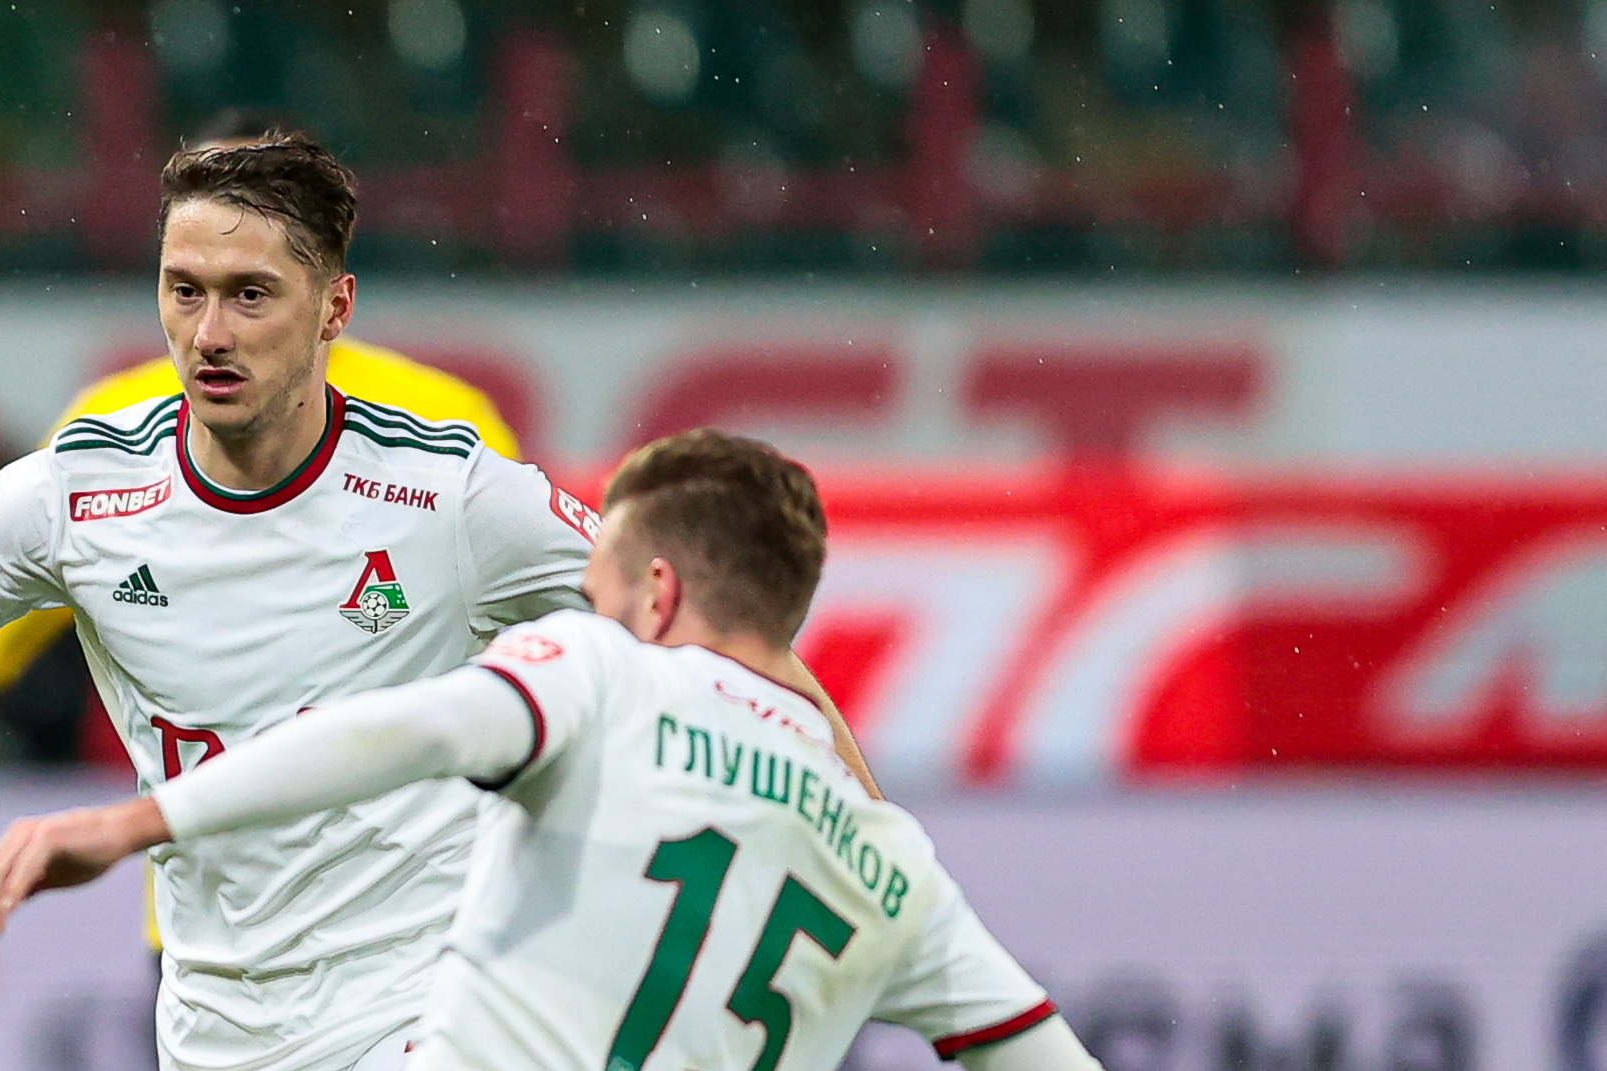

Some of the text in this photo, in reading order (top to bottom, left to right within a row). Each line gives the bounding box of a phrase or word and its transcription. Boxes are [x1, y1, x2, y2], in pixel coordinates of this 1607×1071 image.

[74, 479, 170, 518] FONBET
[343, 473, 439, 511] ТКБ БАНК
[112, 588, 169, 607] adidas
[655, 712, 909, 918] ГЛУШЕНКОВ
